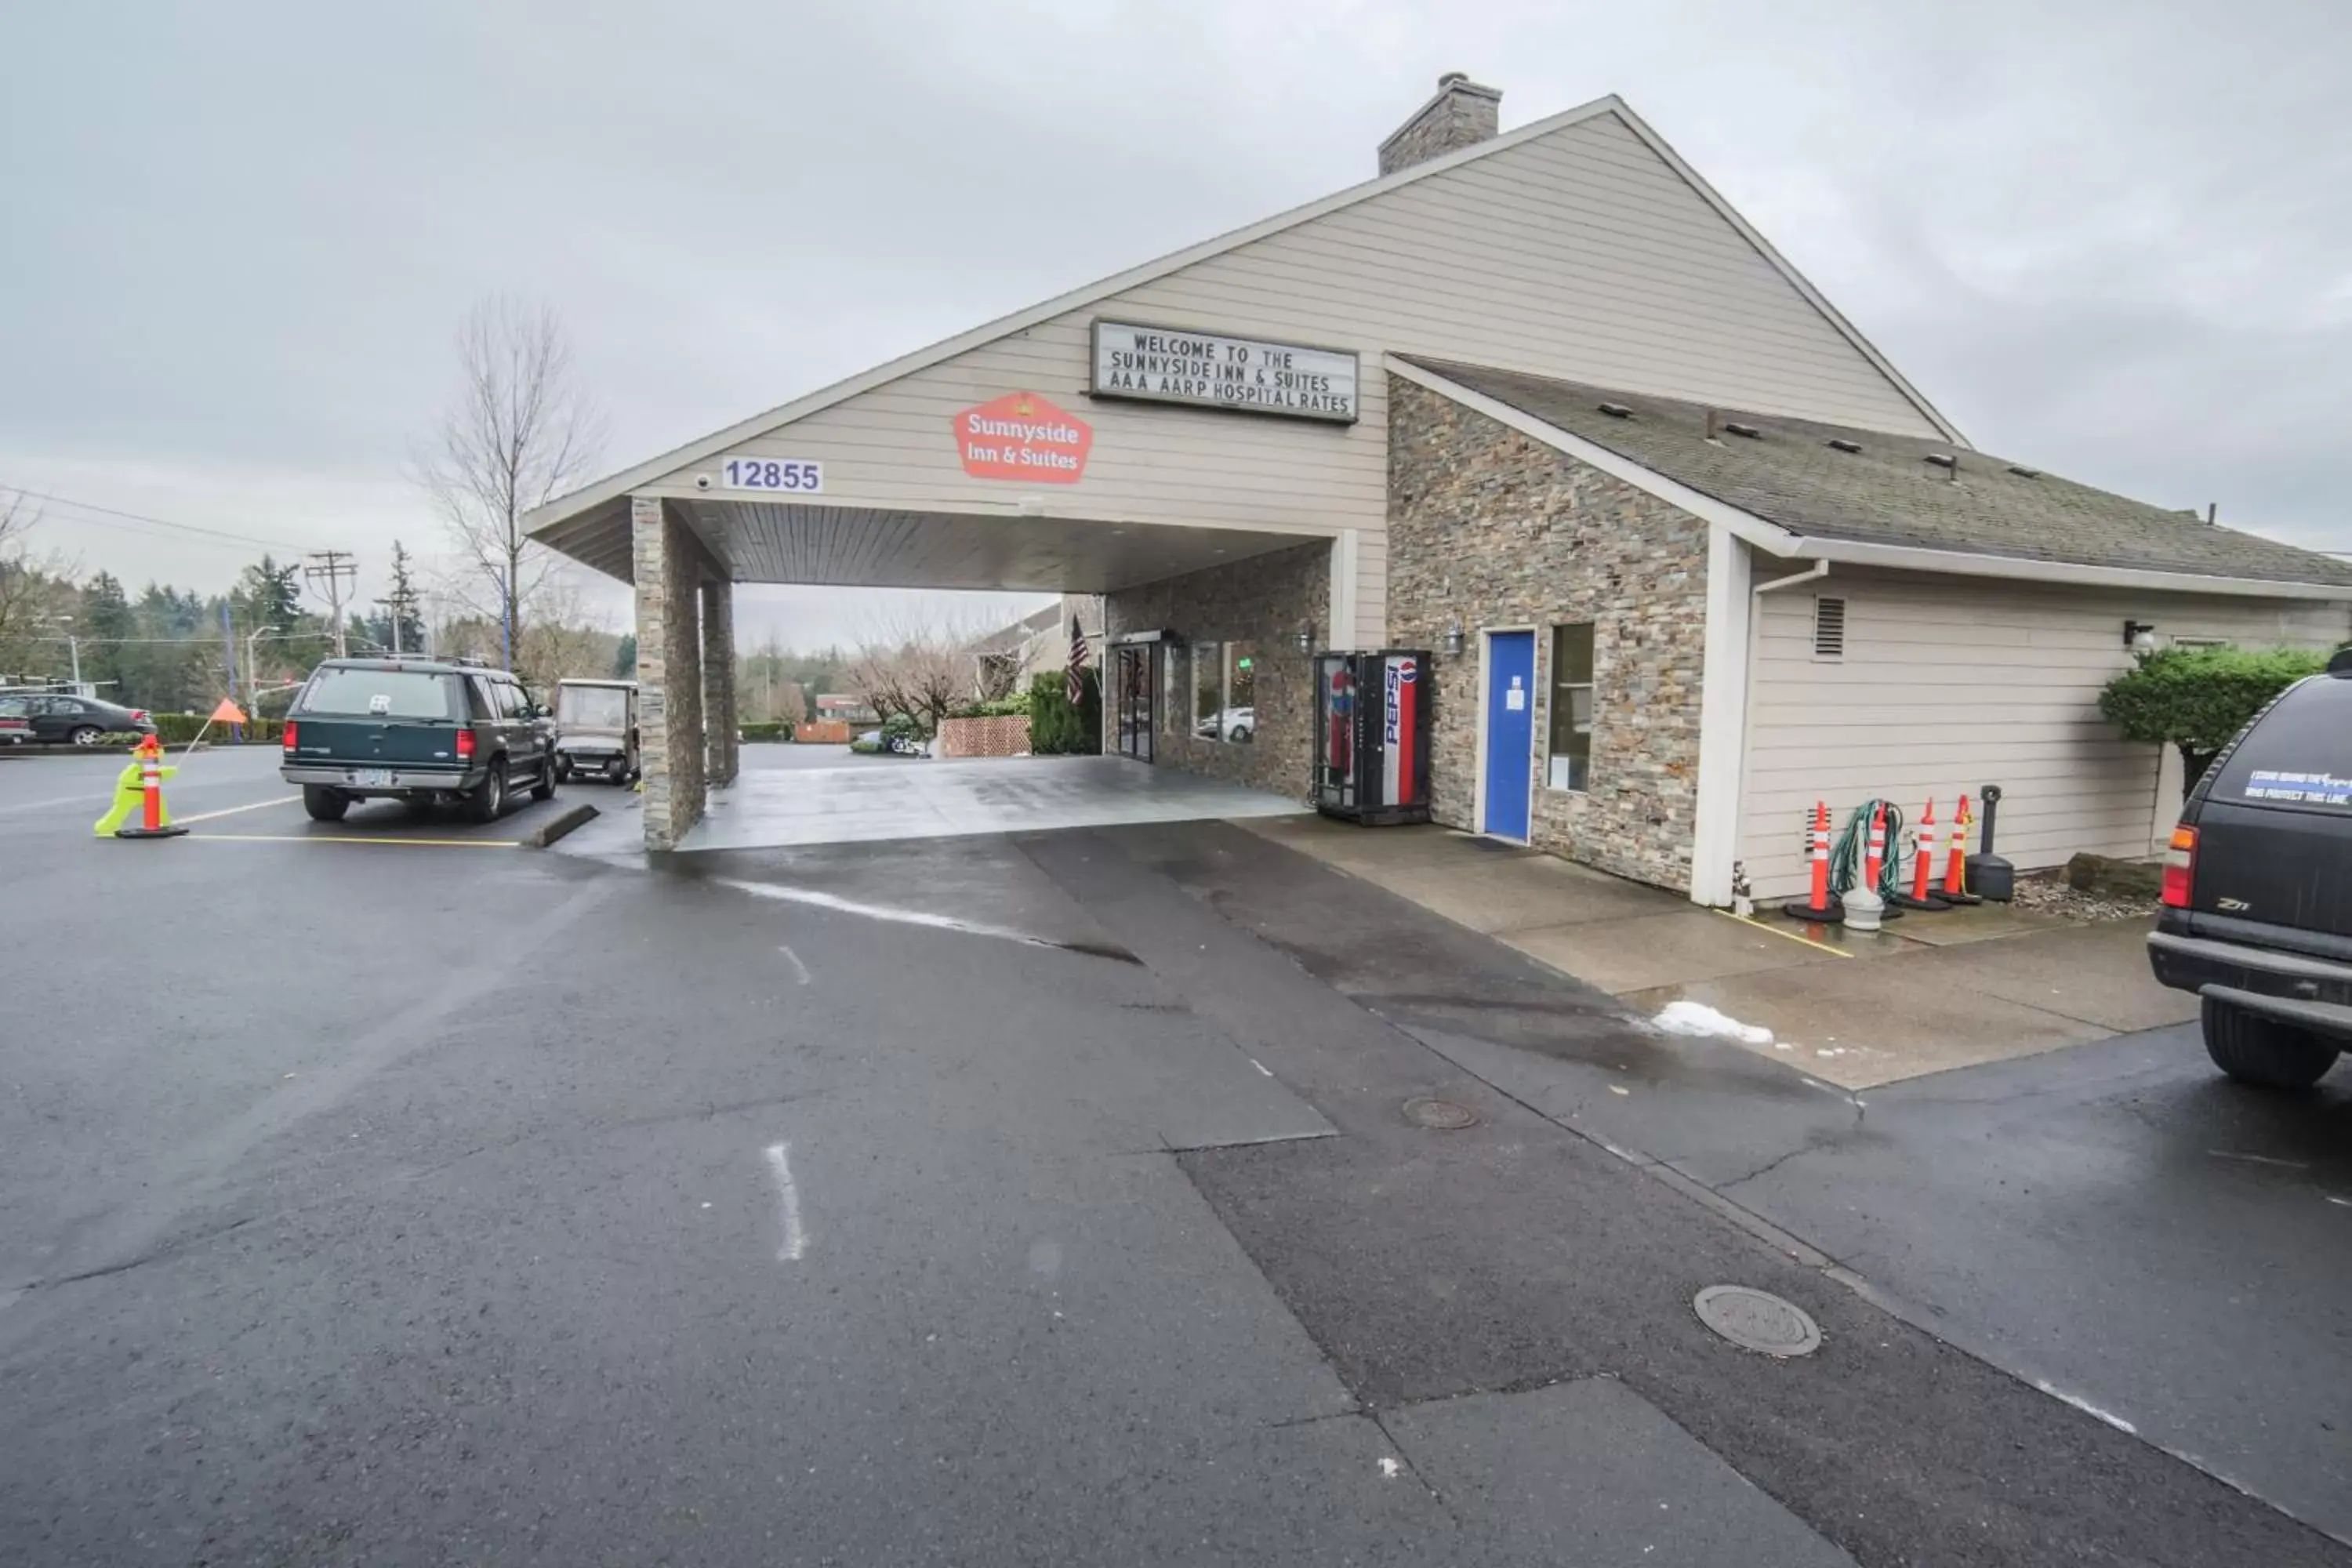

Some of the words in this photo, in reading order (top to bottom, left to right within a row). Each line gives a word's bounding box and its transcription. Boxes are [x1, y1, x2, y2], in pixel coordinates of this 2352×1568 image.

[1134, 333, 1214, 359] WELCOME
[1227, 345, 1248, 363] TO
[1263, 350, 1293, 368] THE
[1112, 350, 1210, 378] SUNNYSIDE
[1216, 364, 1245, 383] INN
[1256, 368, 1265, 384] &
[1275, 371, 1330, 392] SUITES
[1110, 370, 1148, 390] AAA
[1160, 377, 1207, 395] AARP
[1214, 383, 1294, 406] HOSPITAL
[1300, 393, 1348, 412] RATES
[968, 413, 1079, 445] Sunnyside
[967, 442, 999, 463] Inn
[1004, 445, 1017, 464] &
[1020, 448, 1078, 470] Suites
[726, 460, 818, 490] 12855
[1387, 664, 1399, 745] PEPSI
